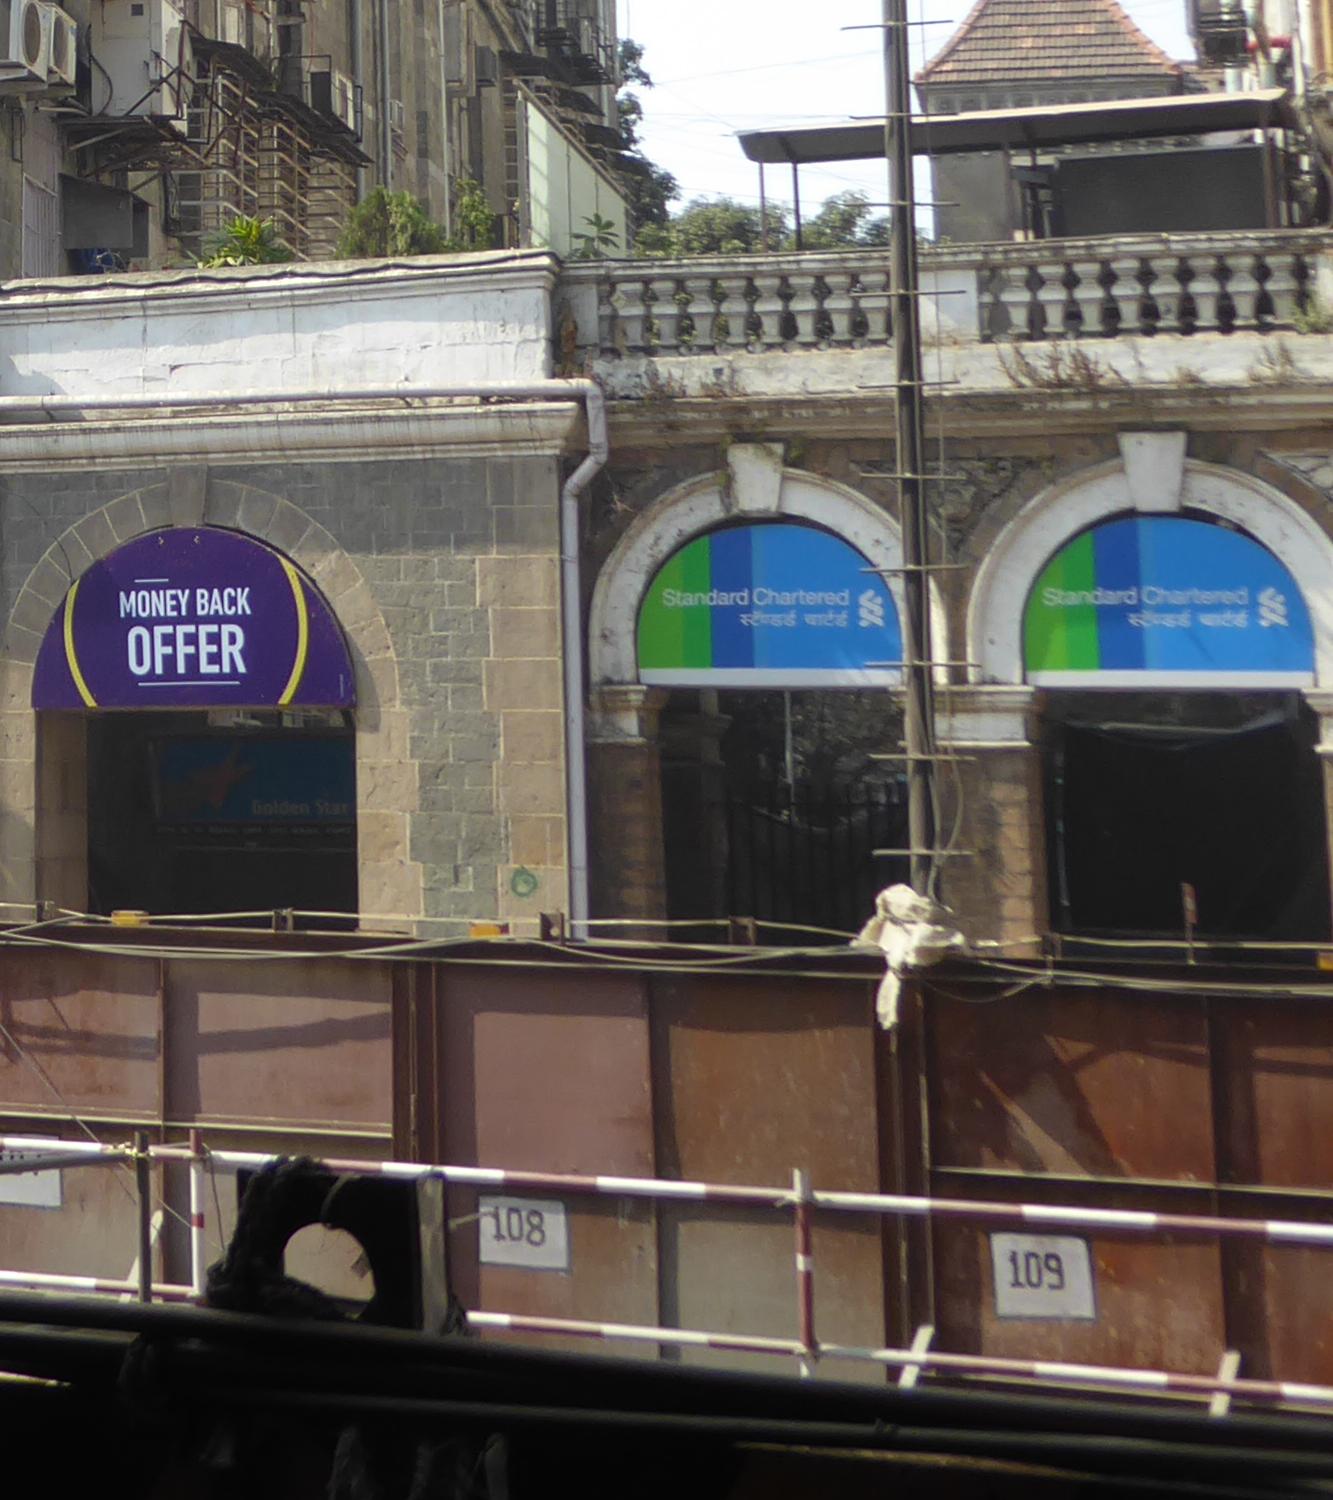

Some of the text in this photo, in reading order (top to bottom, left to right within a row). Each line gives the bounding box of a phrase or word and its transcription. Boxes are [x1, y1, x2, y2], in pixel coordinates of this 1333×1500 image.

[118, 586, 252, 618] MONEY BACK
[662, 587, 850, 607] Standard Chartered
[1042, 586, 1249, 606] Standard Chartered
[127, 623, 248, 676] OFFER
[493, 1206, 546, 1247] 108
[1009, 1251, 1065, 1291] 109
